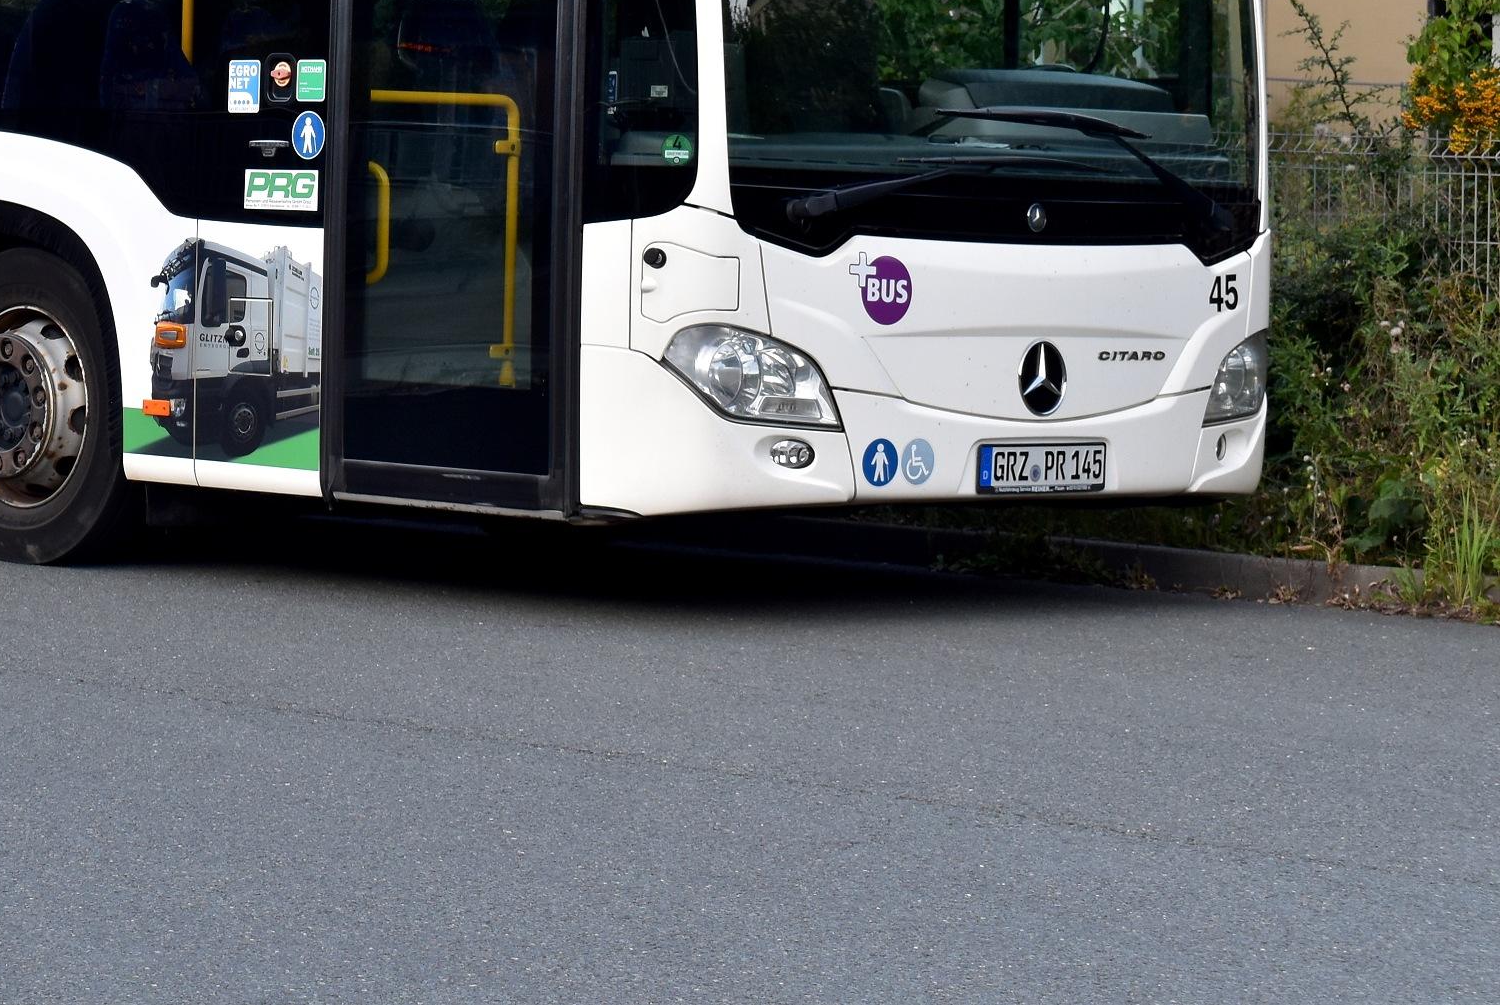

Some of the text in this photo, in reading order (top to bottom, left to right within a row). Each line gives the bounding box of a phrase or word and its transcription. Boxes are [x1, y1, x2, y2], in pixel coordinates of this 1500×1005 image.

[228, 64, 258, 77] EGRO
[228, 77, 251, 90] NET
[673, 135, 682, 150] 4
[246, 171, 316, 199] PRG
[1208, 274, 1239, 312] 45
[1097, 350, 1166, 362] CITARO
[982, 449, 1103, 482] D GRZ PR 145
